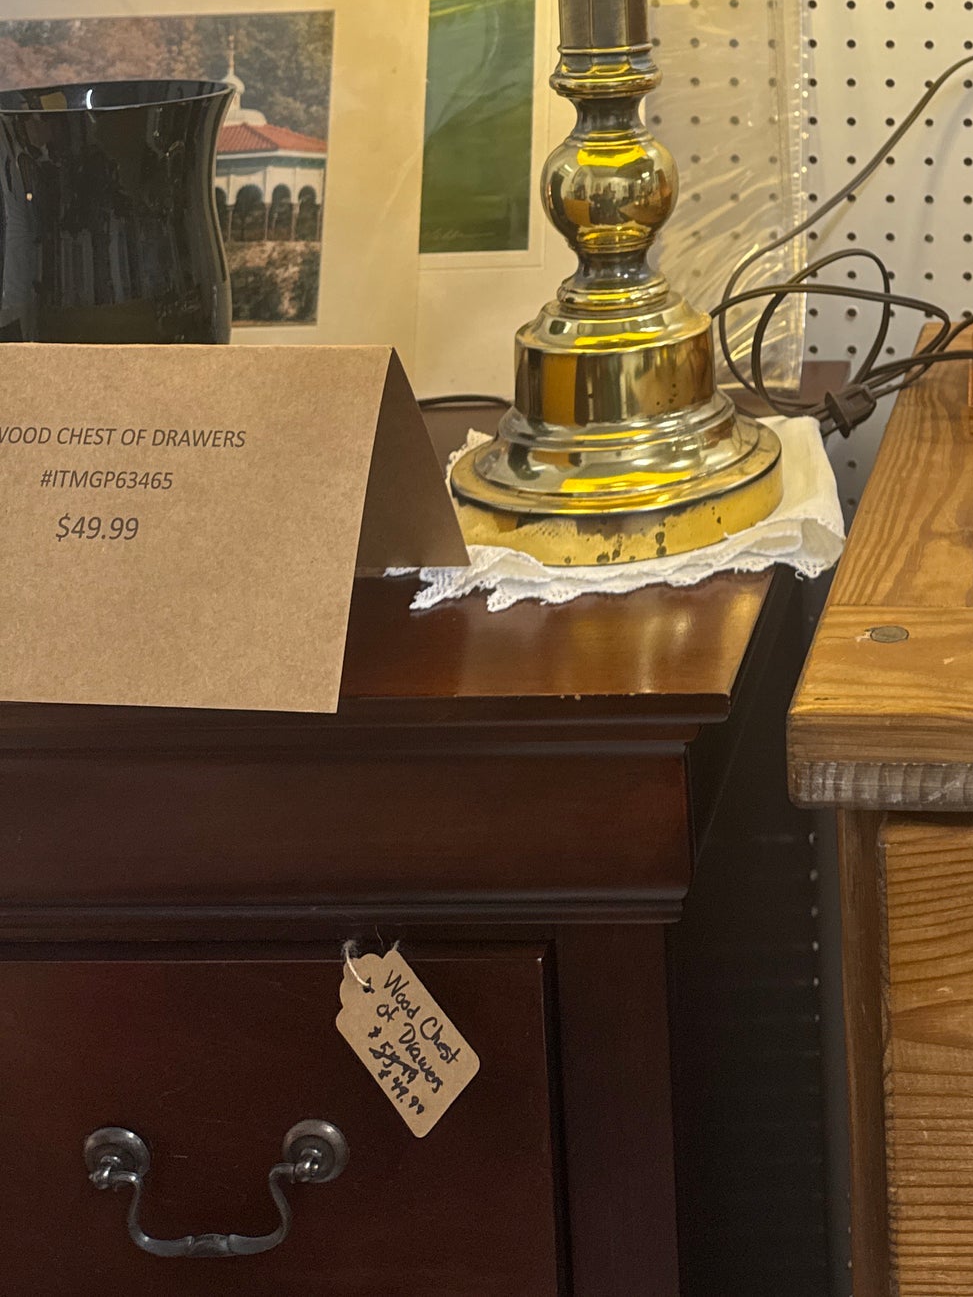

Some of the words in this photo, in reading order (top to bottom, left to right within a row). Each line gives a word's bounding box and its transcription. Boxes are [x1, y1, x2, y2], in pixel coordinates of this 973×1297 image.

[57, 427, 117, 446] CHEST
[120, 429, 147, 447] OF
[151, 429, 247, 448] DRAWERS
[40, 469, 174, 490] #ITMGP63465
[55, 513, 140, 542] $49.99
[383, 969, 421, 1020] Wood
[419, 1016, 461, 1064] Chest
